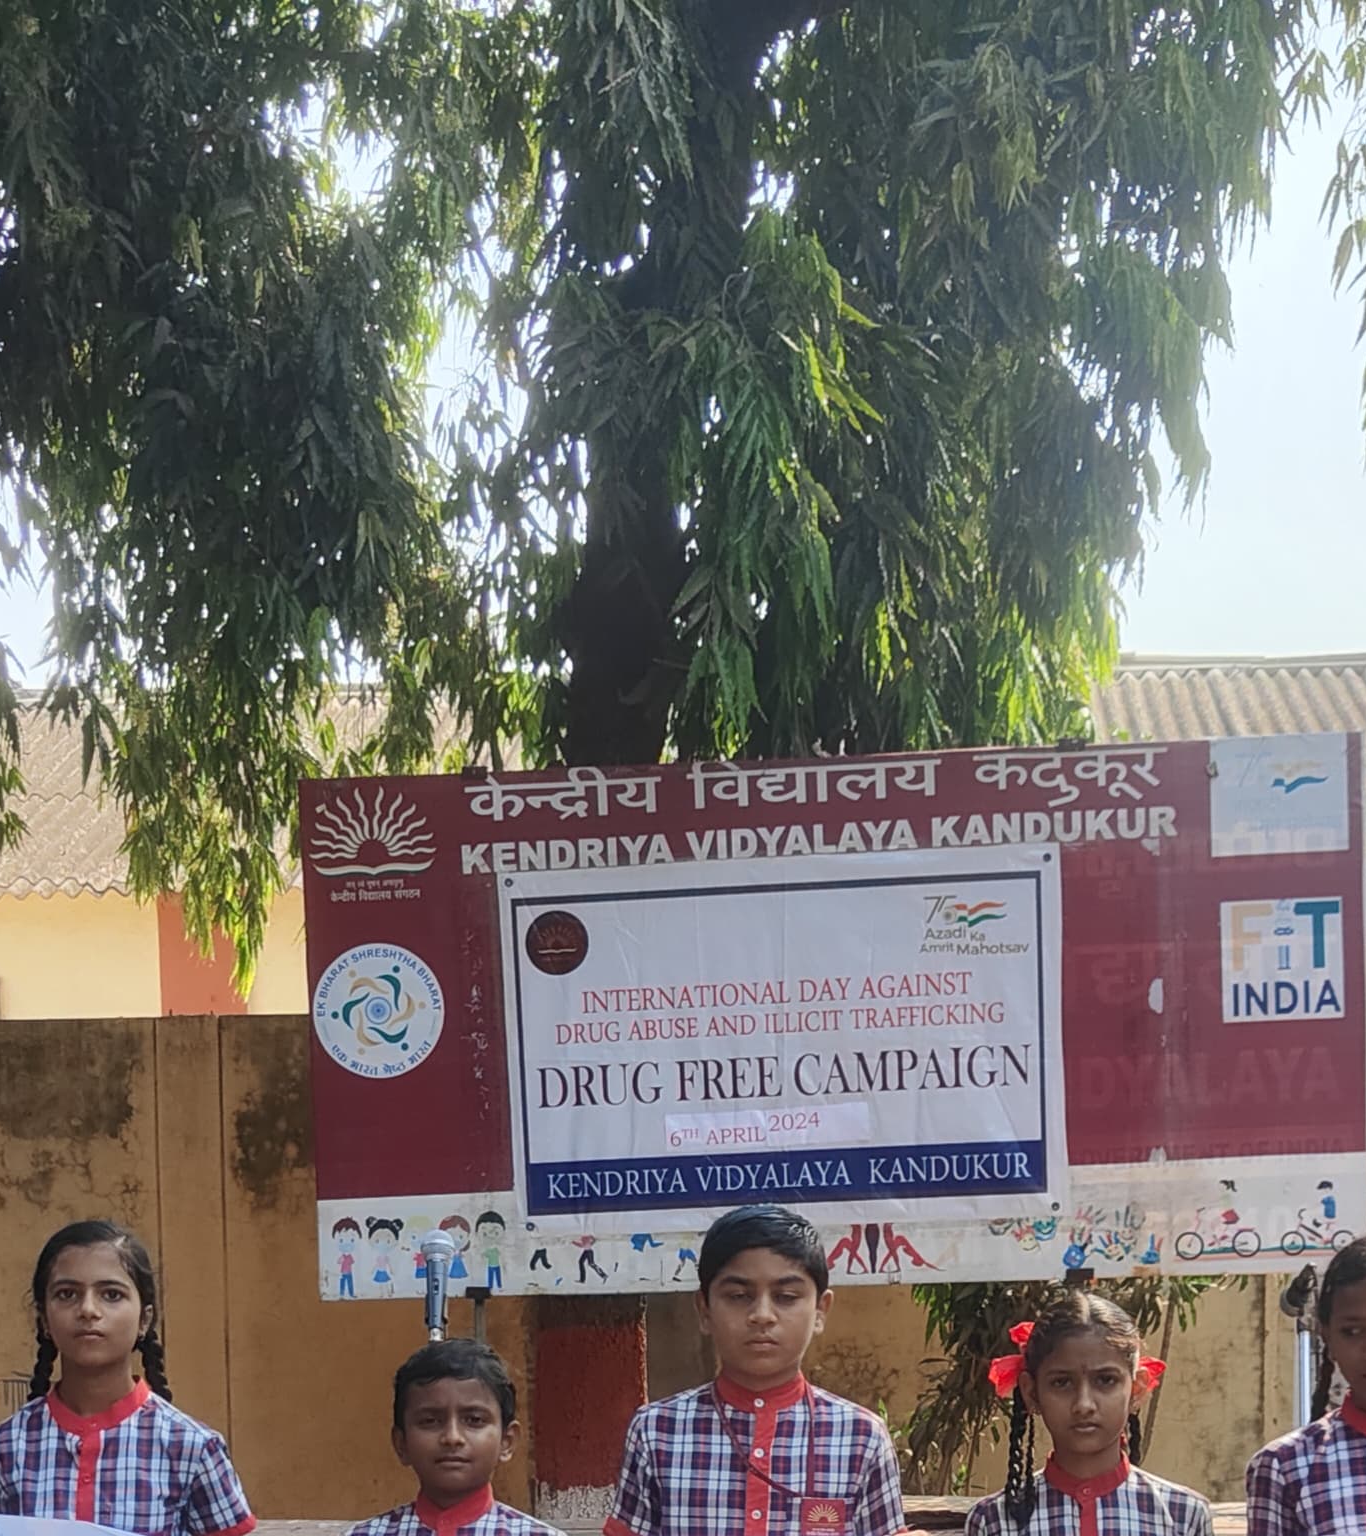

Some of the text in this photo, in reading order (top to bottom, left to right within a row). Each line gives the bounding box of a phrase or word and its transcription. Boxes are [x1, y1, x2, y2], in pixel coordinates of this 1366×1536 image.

[464, 766, 662, 822] केन्द्रीय
[686, 758, 942, 810] विद्यालय
[461, 805, 1178, 875] KENDRIYA VIDYALAYA KANDUKUR
[919, 942, 1030, 955] Amrit Mahotsav
[924, 924, 986, 942] Azadi Ka
[319, 959, 349, 999] BHARAT
[350, 948, 417, 969] SHRESHTHA
[416, 967, 442, 1011] BHARAT
[581, 971, 973, 1014] INTERNATIONAL DAY AGAINST
[1232, 979, 1341, 1018] INDIA
[555, 1001, 1005, 1046] DRUG ABUSE AND ILLICIT TRAFFICKING
[350, 1061, 378, 1075] भारत
[408, 1040, 433, 1065] भारत
[536, 1043, 1033, 1110] DRUG FREE CAMPAIGN
[706, 1124, 767, 1146] APRIL
[768, 1111, 821, 1132] 2024
[547, 1152, 1033, 1200] KENDRIYA VIDYALAYA KANDUKUR
